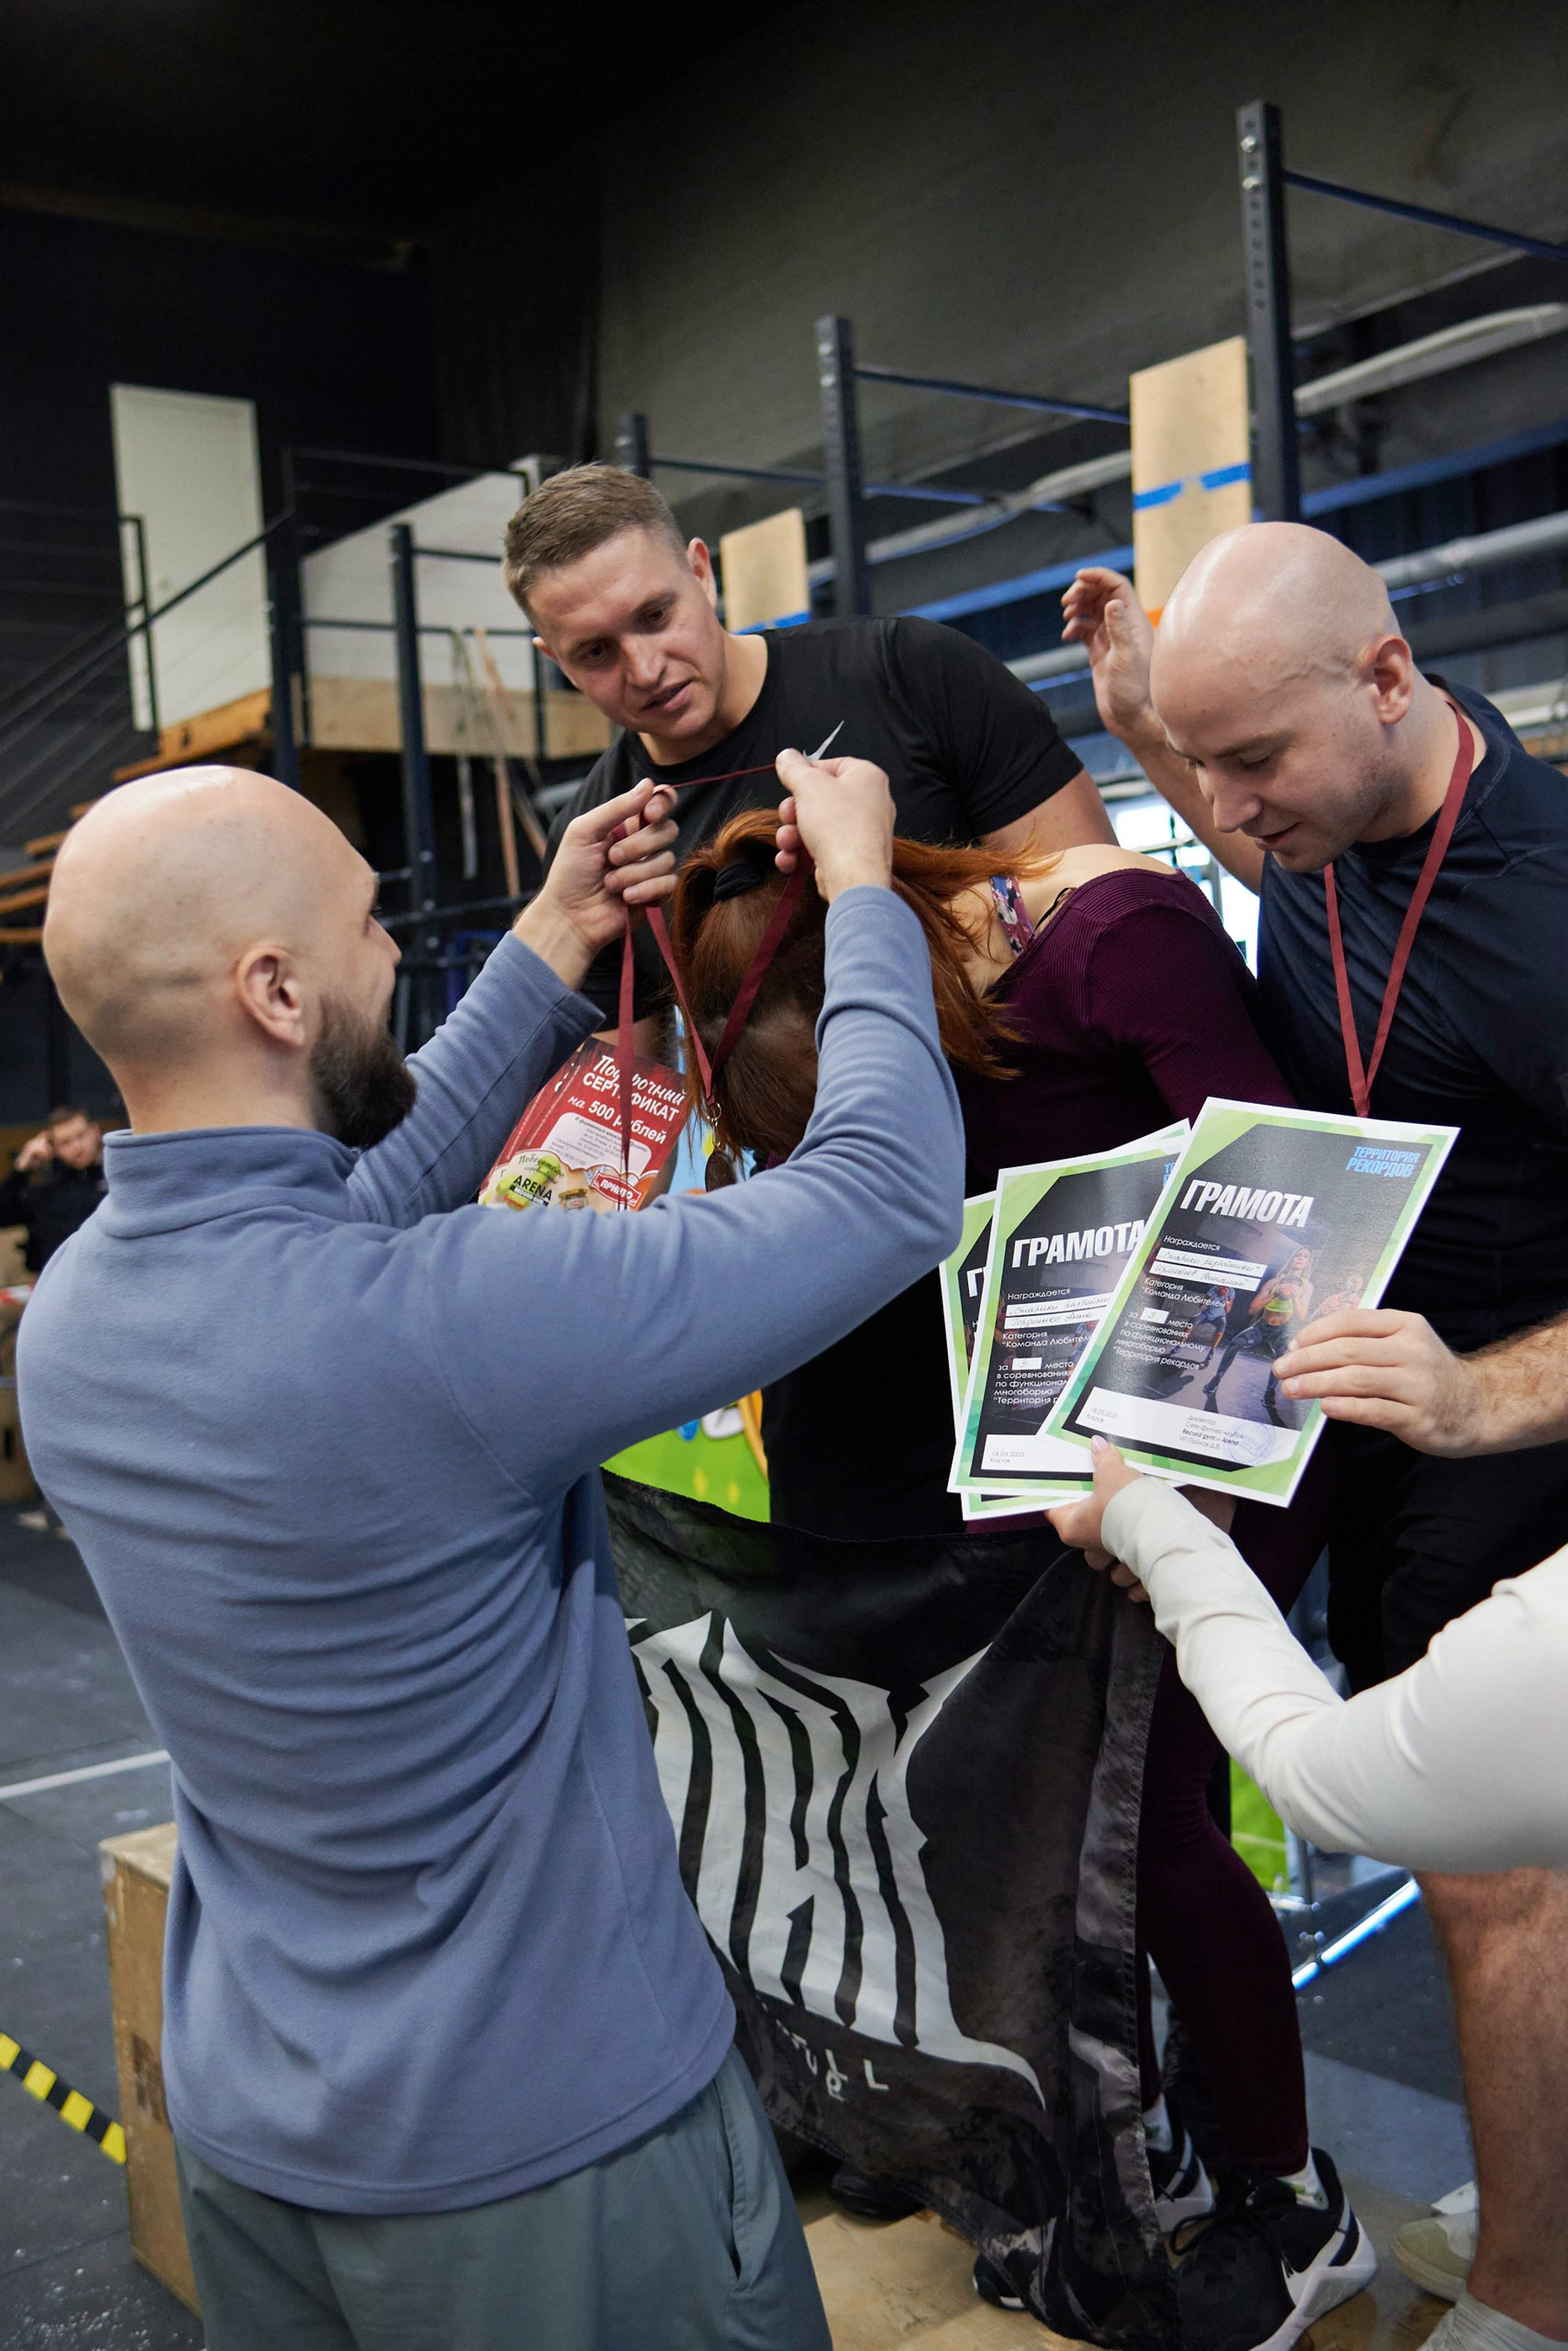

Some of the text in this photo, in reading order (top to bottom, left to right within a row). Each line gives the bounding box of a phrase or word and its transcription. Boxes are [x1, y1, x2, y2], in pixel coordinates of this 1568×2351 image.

[593, 1055, 687, 1106] Подрочный
[583, 1072, 680, 1122] СЕРТФИКАТ
[568, 1096, 586, 1108] на
[588, 1100, 615, 1120] 500
[612, 1113, 667, 1145] рблей
[1353, 1146, 1421, 1163] ТЕРРИТОРИЯ
[1345, 1157, 1414, 1177] РЕКОРДОВ
[514, 1175, 552, 1201] ARENA
[1180, 1179, 1314, 1228] ГРАМОТА
[1011, 1219, 1145, 1268] ГРАМОТА
[1163, 1235, 1221, 1251] Награждается
[1144, 1277, 1184, 1291] Категория
[1007, 1288, 1071, 1301] Награждается
[1130, 1322, 1189, 1338] соревнованиях
[1167, 1319, 1193, 1329] место
[1002, 1331, 1048, 1340] Категория
[1131, 1330, 1206, 1352] функциональному
[1115, 1338, 1166, 1354] многоборью
[1044, 1361, 1074, 1370] место
[1004, 1370, 1073, 1380] соревнованиях
[993, 1388, 1054, 1397] многоборью
[1187, 1414, 1217, 1426] Директор
[1182, 1428, 1202, 1438] Record
[1221, 1436, 1240, 1446] Arena
